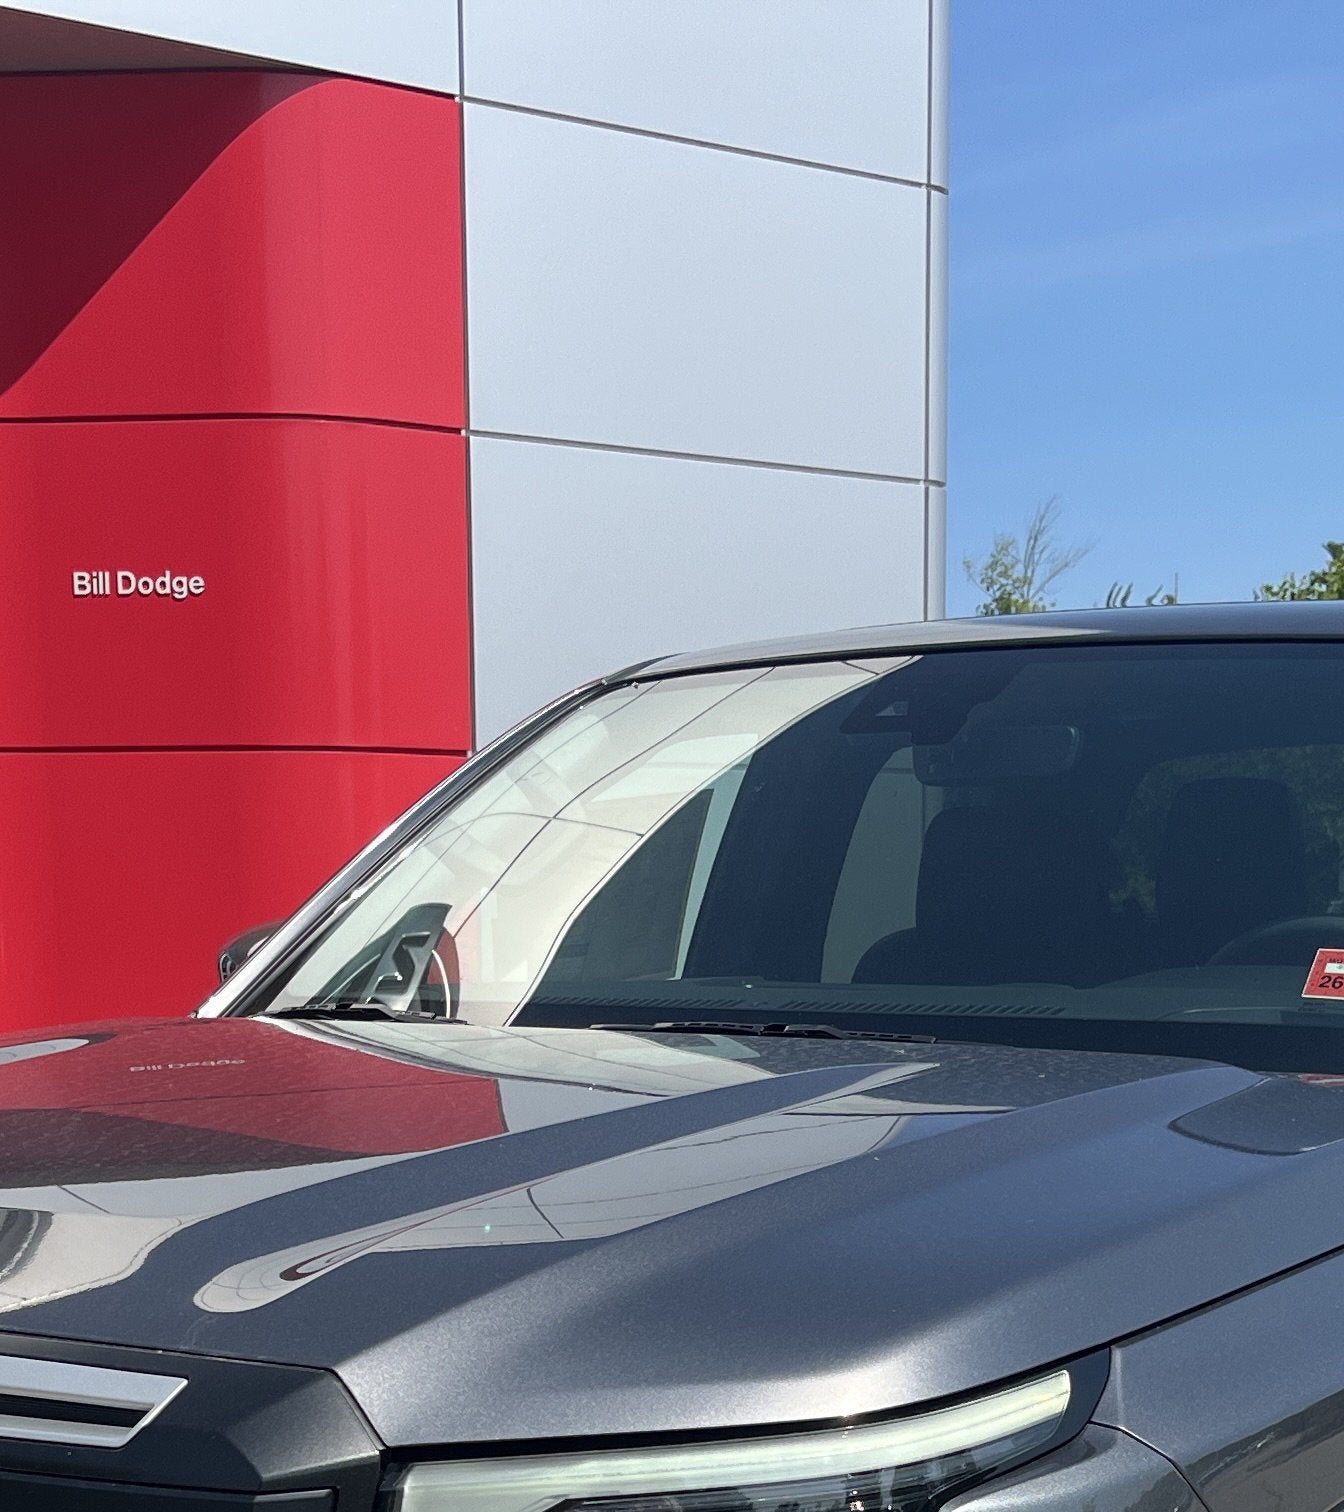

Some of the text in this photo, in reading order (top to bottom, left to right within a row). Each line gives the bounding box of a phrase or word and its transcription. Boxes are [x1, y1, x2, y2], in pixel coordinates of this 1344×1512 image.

[72, 569, 205, 600] Bill Dodge
[1317, 974, 1344, 990] 26
